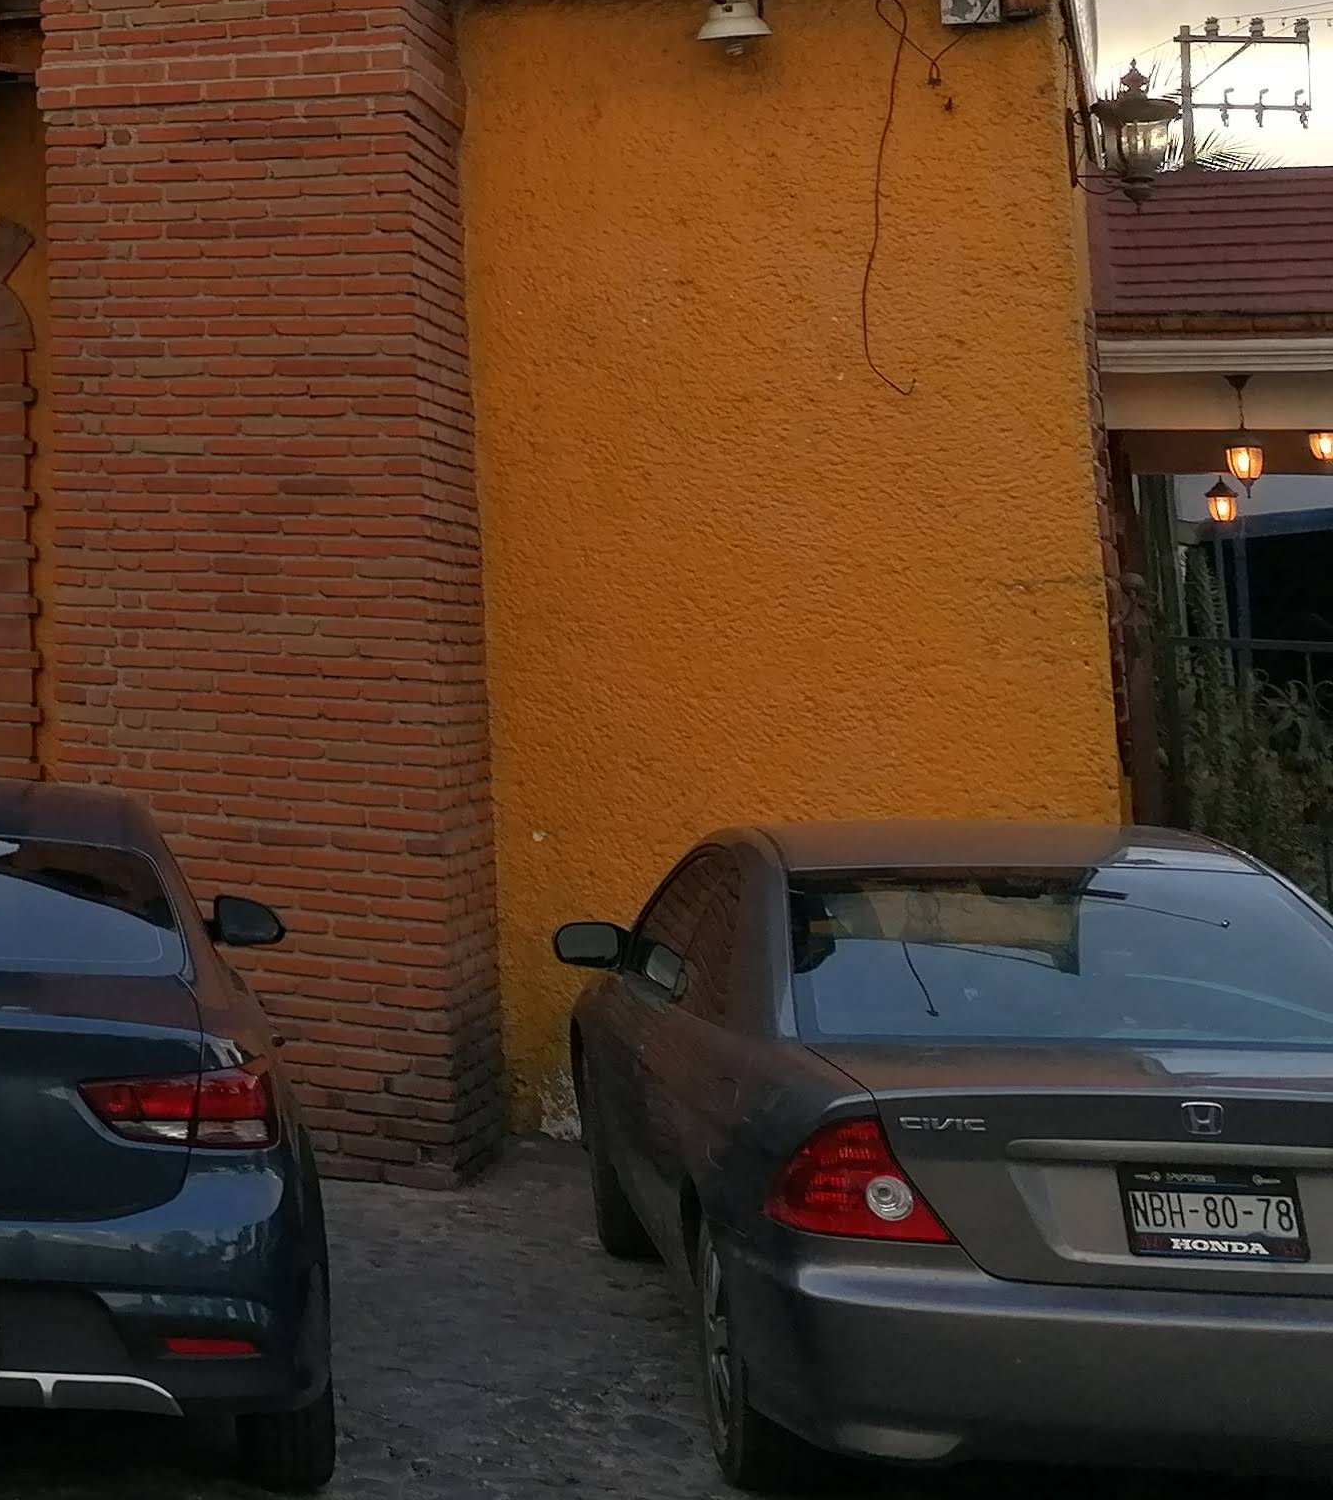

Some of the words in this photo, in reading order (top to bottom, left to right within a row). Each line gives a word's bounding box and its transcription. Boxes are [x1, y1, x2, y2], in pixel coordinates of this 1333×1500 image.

[899, 1115, 988, 1132] CIVIC
[1131, 1191, 1295, 1232] NBH-80-78
[1169, 1237, 1270, 1256] HONDA
